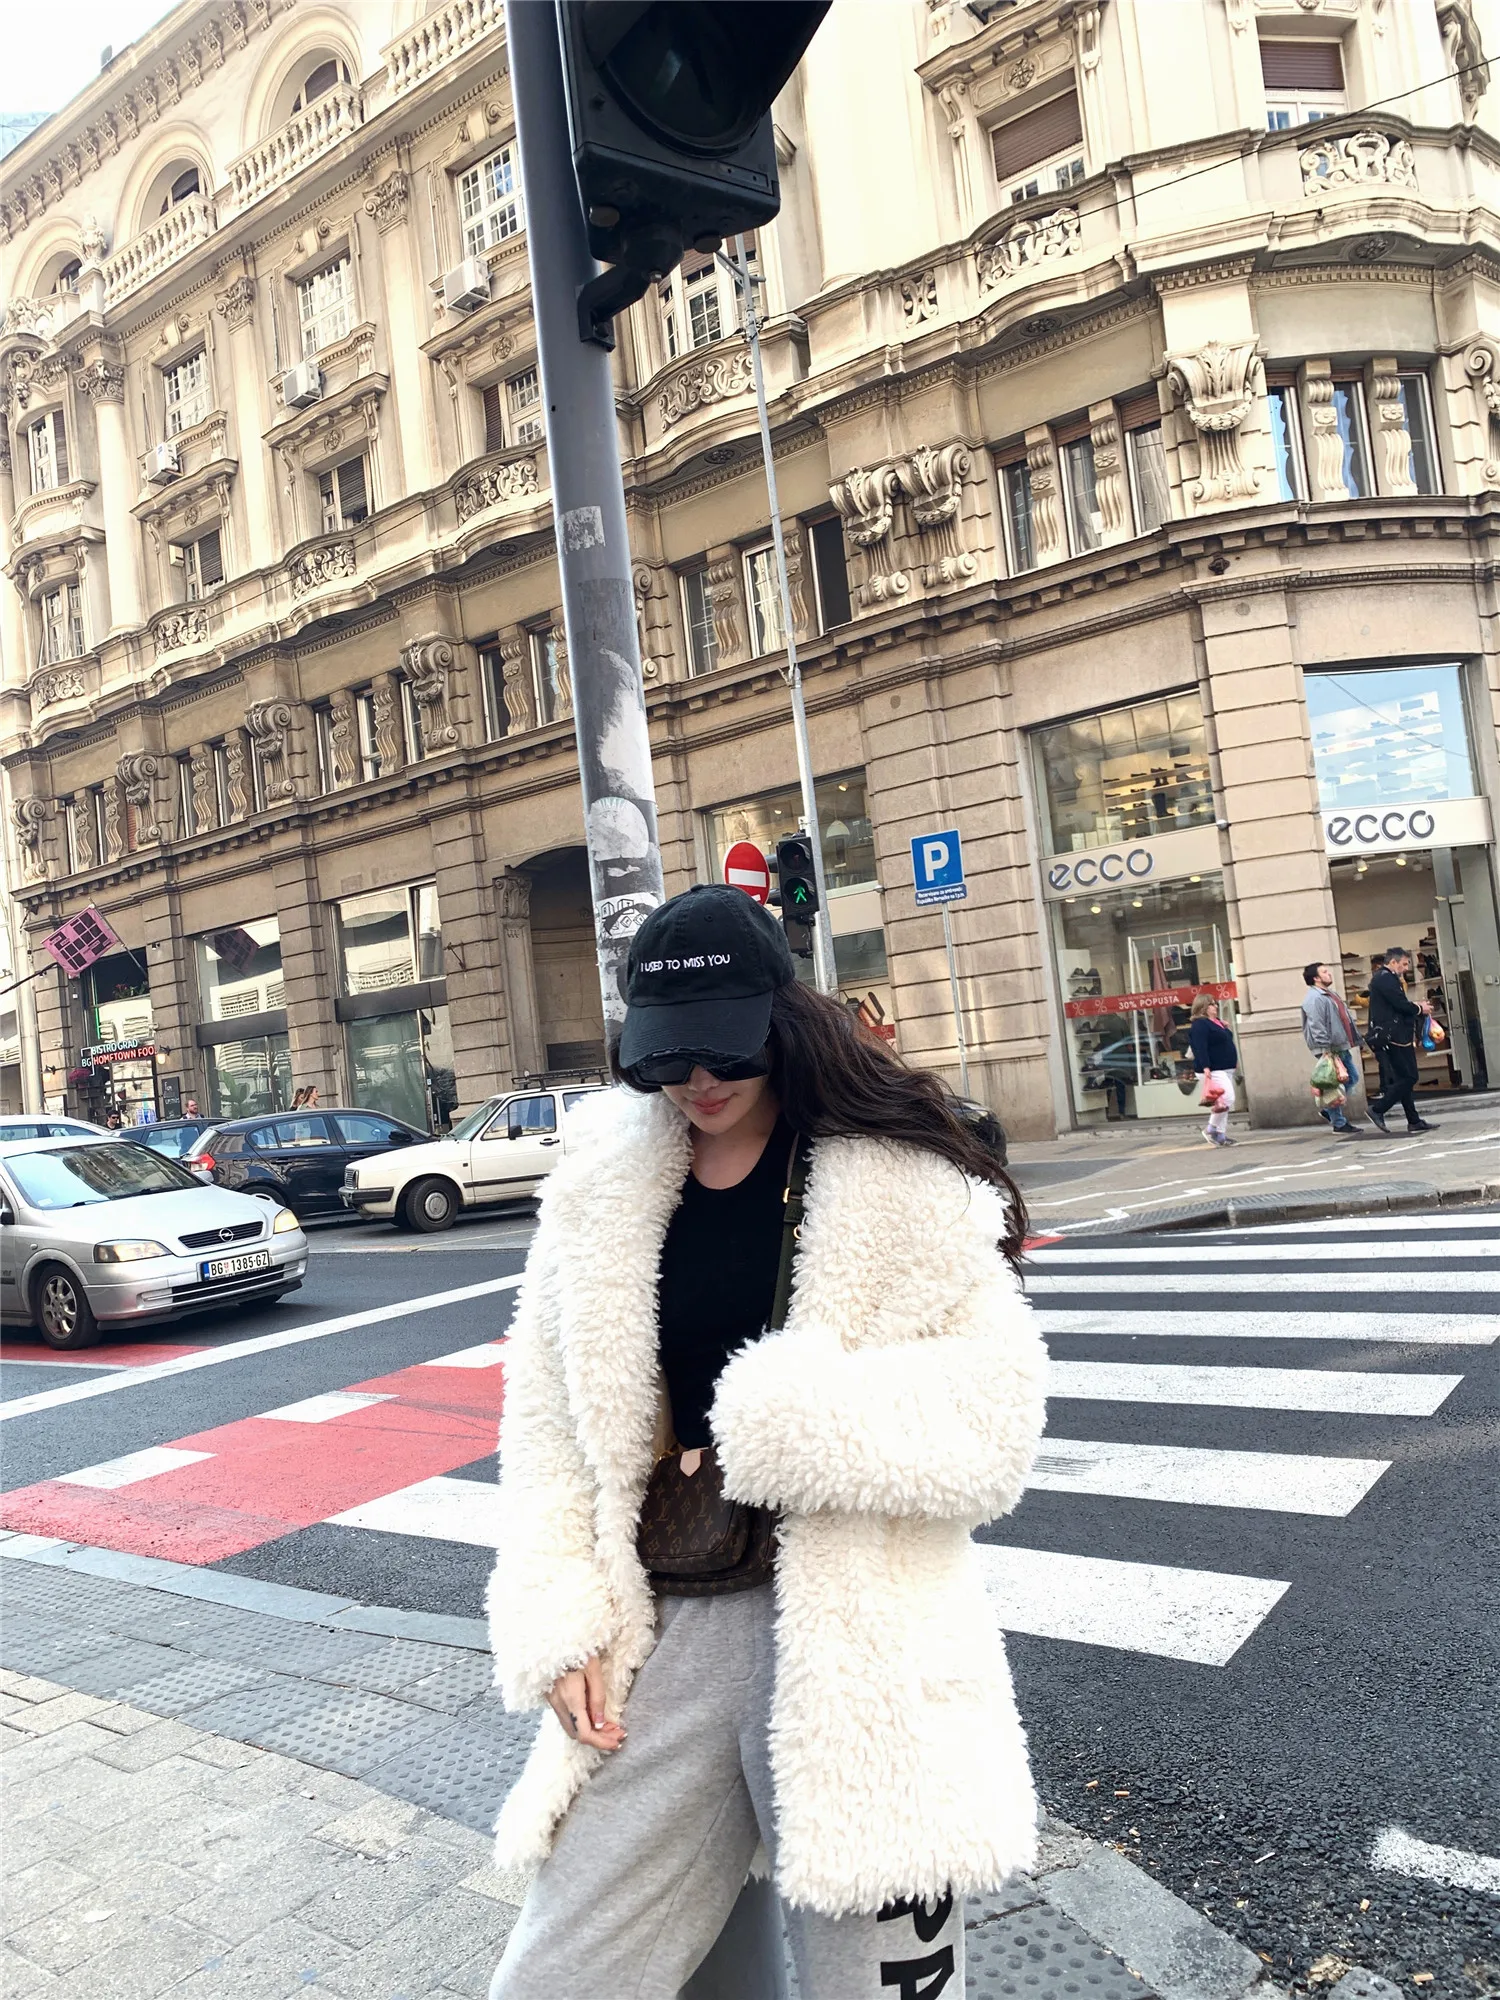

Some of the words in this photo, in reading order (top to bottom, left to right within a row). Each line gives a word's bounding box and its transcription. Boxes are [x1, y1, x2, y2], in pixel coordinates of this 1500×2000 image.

[1326, 810, 1435, 845] ecco
[923, 841, 949, 881] P
[1048, 848, 1154, 891] ecco
[640, 962, 644, 973] I
[645, 960, 663, 973] USED
[665, 959, 680, 970] TO
[683, 956, 705, 969] MISS
[707, 954, 730, 967] YOU
[1118, 1001, 1137, 1011] 30%
[1139, 995, 1180, 1008] POPUSTA
[81, 1057, 92, 1067] BG
[93, 1051, 137, 1065] HOMETOWN
[138, 1045, 158, 1057] FOO
[91, 1042, 117, 1055] BISTRO
[118, 1039, 138, 1051] GRAD
[210, 1262, 224, 1276] BG
